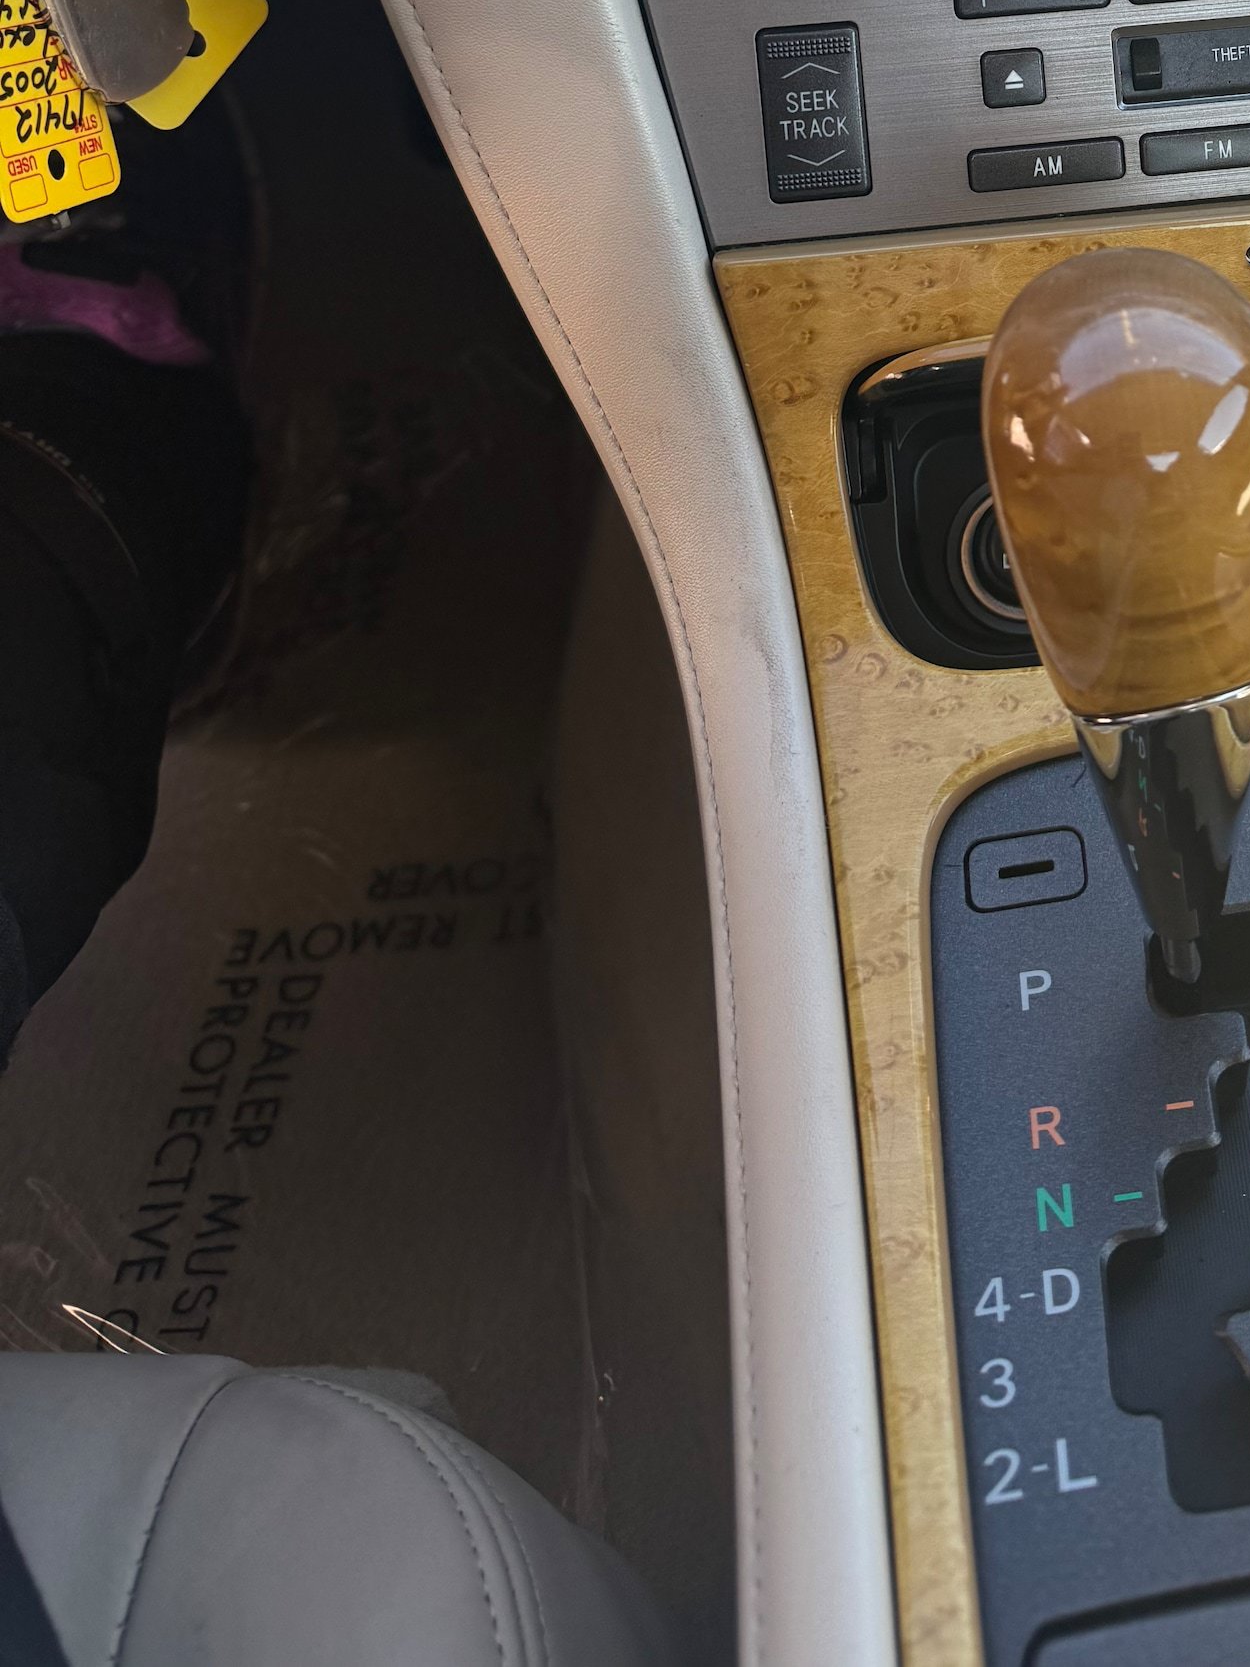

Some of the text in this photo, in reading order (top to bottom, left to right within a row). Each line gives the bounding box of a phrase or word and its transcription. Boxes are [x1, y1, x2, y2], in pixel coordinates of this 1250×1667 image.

[0, 56, 58, 96] 2005
[785, 89, 840, 113] SEEK
[79, 135, 104, 157] NEW
[779, 116, 850, 141] TRACK
[7, 152, 39, 177] USED
[1032, 155, 1063, 179] AM
[1203, 139, 1234, 161] FM
[224, 909, 460, 967] REMOVE
[1018, 968, 1053, 1011] P
[114, 975, 260, 1286] PROTECTIVE
[1028, 1104, 1066, 1150] R
[158, 973, 325, 1342] DEALER MUST
[1035, 1183, 1075, 1233] N
[978, 1358, 1017, 1409] 3
